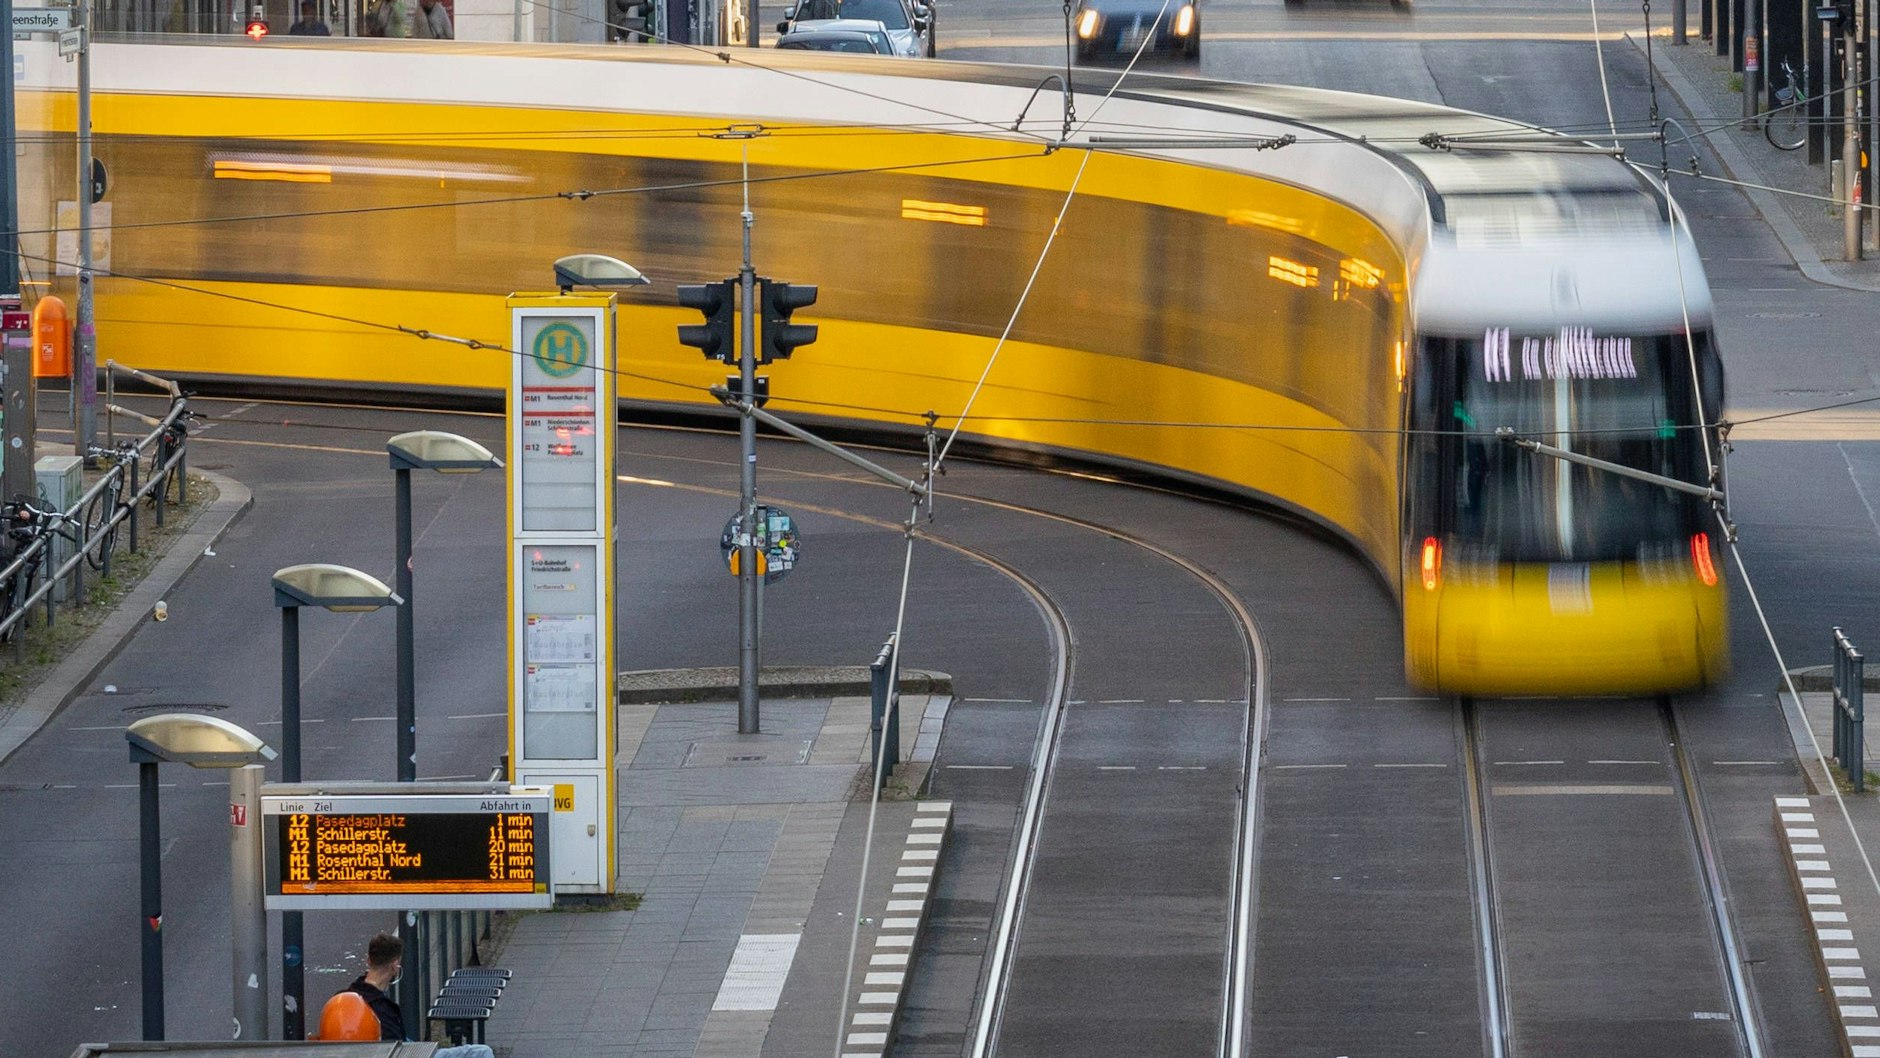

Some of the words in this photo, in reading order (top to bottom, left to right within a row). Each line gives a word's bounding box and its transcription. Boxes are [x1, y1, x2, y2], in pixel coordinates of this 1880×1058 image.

[530, 395, 541, 403] M1
[280, 802, 304, 812] Linie
[314, 802, 333, 812] Ziel
[480, 801, 519, 811] Abfahrt
[522, 801, 532, 811] in
[290, 814, 310, 828] 12
[316, 814, 406, 829] Pasedagplatz
[497, 813, 504, 826] 1
[508, 813, 533, 826] min
[288, 827, 310, 840] M1
[316, 827, 391, 840] Schillerstr.
[489, 826, 504, 839] 11
[508, 826, 533, 839] min
[290, 840, 310, 854] 12
[316, 840, 407, 855] Pasedagplatz
[488, 840, 506, 852] 20
[508, 840, 533, 852] min
[289, 854, 310, 867] M1
[317, 853, 385, 867] Rosenthal
[390, 853, 422, 867] Nord
[489, 853, 505, 866] 21
[508, 853, 534, 866] min
[290, 867, 311, 881] M1
[317, 867, 392, 881] Schillerstr.
[489, 866, 505, 879] 31
[509, 866, 534, 879] min
